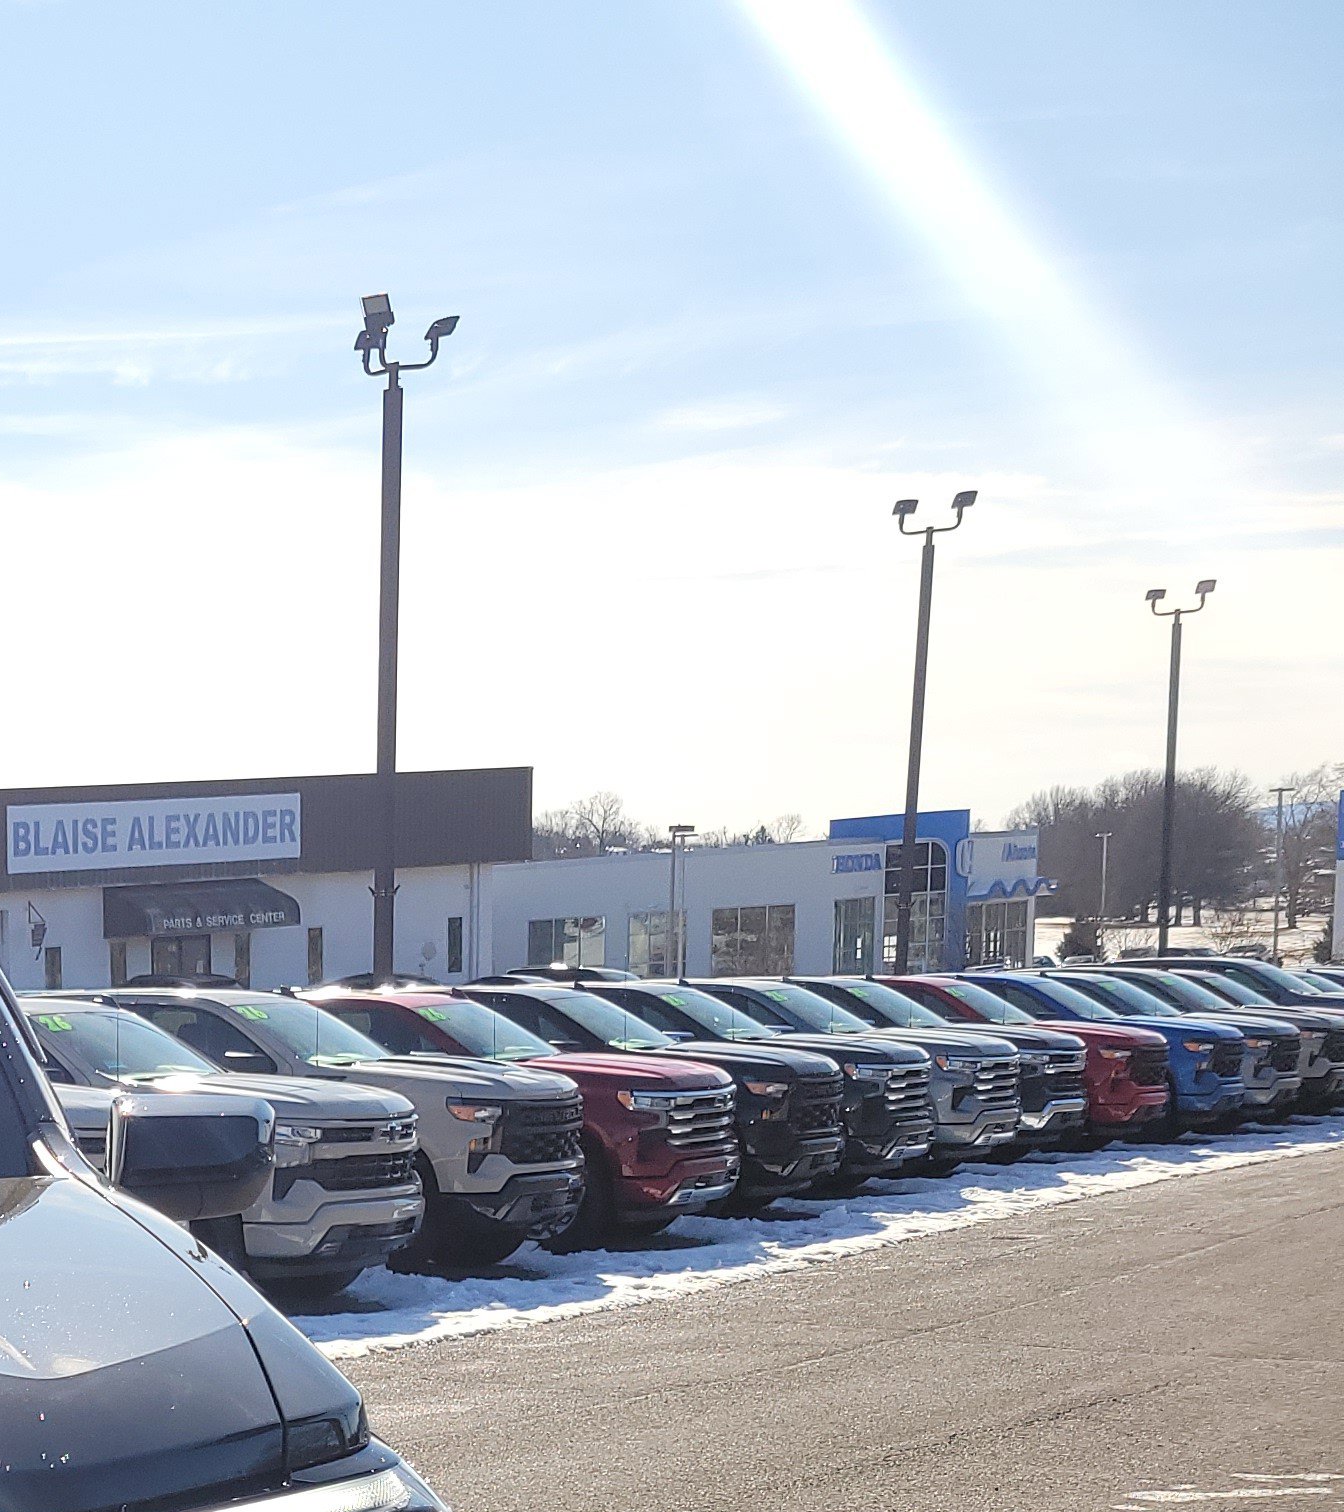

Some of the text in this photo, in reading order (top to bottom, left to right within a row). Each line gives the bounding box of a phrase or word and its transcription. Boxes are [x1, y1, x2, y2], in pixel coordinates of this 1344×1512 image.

[12, 808, 297, 858] BLAISE ALEXANDER
[831, 853, 882, 875] HONDA
[163, 911, 285, 930] PARTS & SERVICE CENTER
